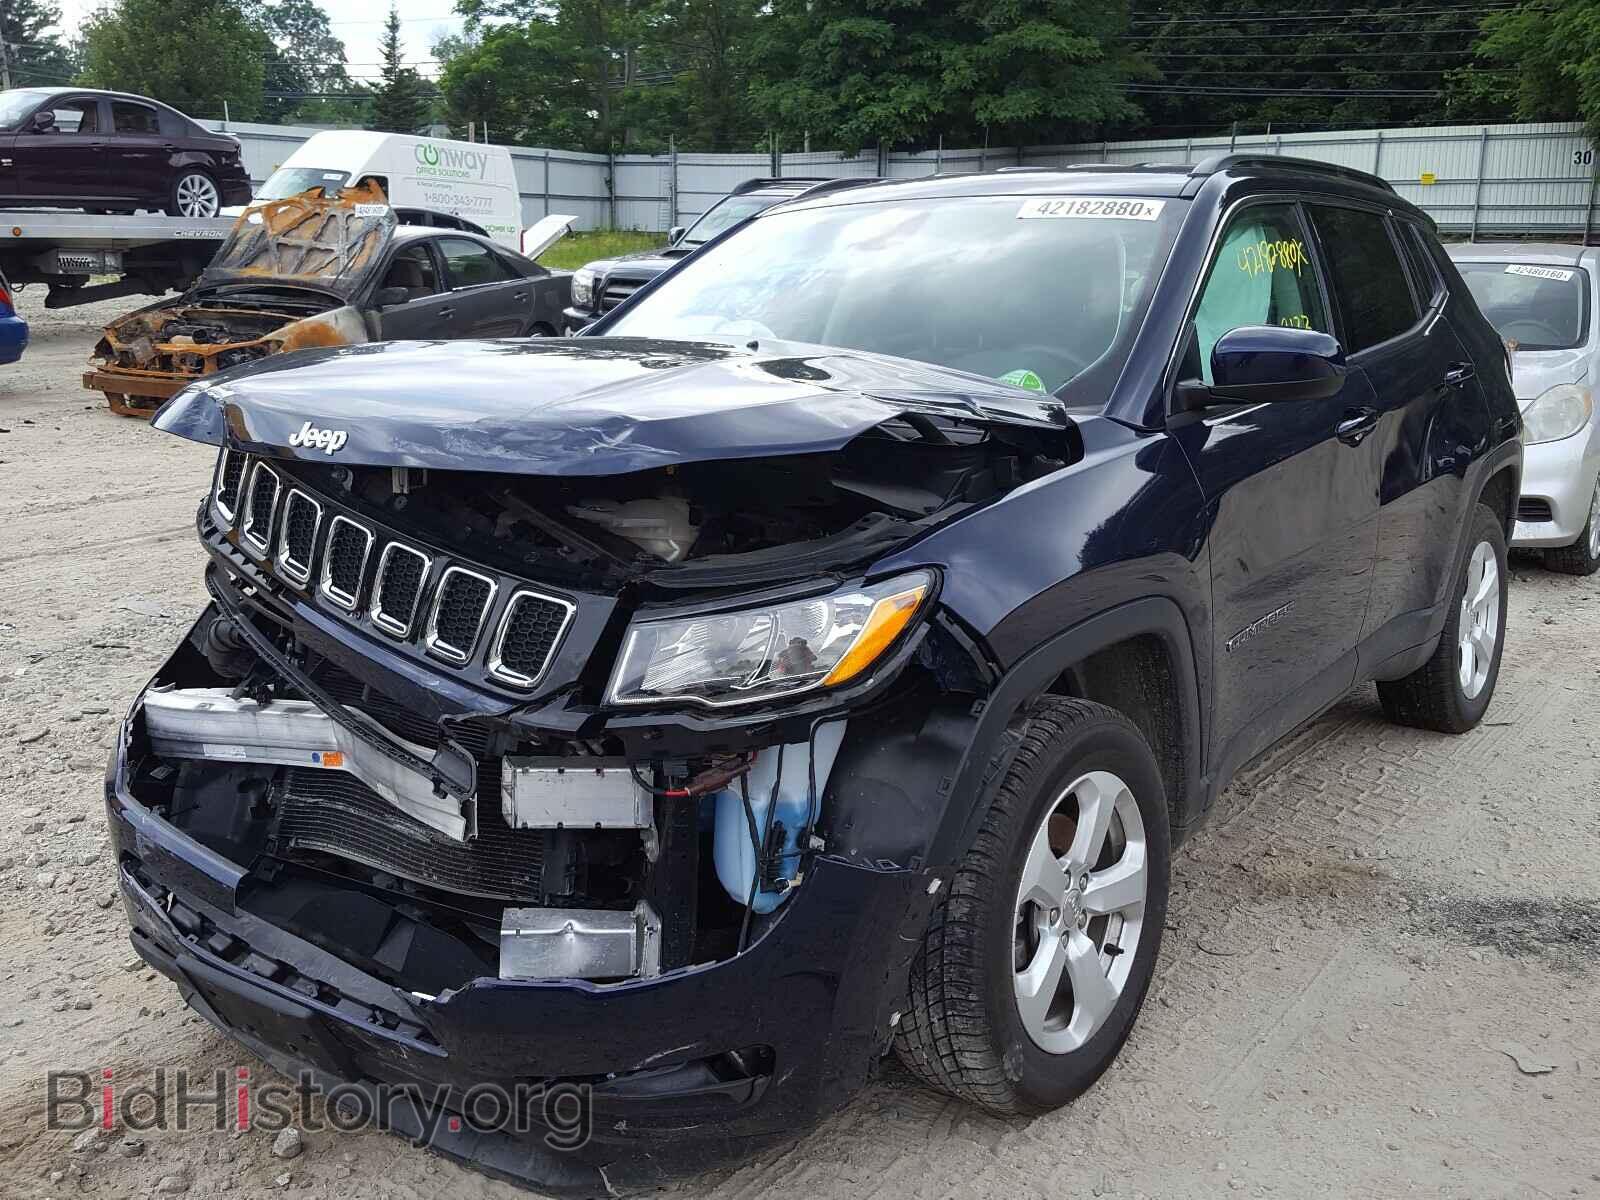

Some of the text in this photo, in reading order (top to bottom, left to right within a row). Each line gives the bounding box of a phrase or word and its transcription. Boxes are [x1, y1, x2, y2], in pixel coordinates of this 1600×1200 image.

[1574, 150, 1592, 165] 30
[416, 167, 471, 178] OFFICE SOLUTIONS
[174, 230, 224, 240] CHEVRON
[289, 421, 349, 456] Jeep
